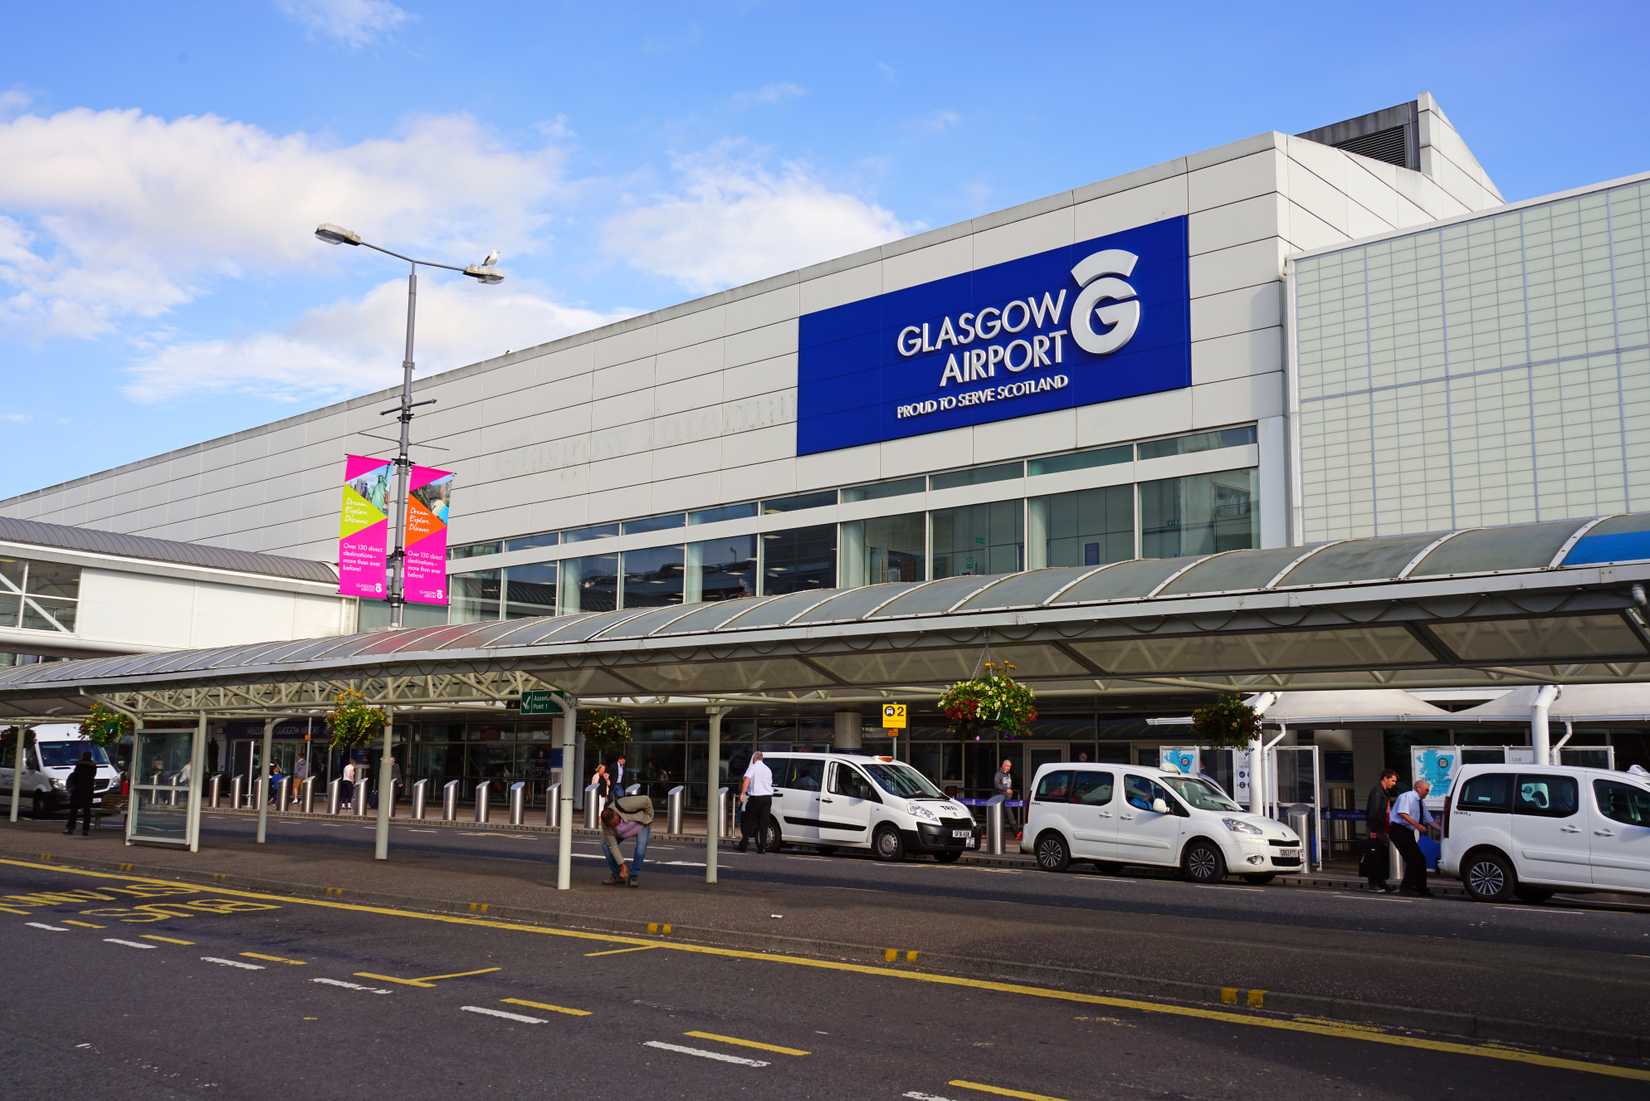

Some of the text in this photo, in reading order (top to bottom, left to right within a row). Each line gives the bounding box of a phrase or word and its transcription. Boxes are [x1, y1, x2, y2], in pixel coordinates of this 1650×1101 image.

[896, 289, 1067, 357] GLASGOW
[939, 330, 1068, 387] AIRPORT
[896, 374, 1068, 419] PROUD TO SERVE SCOTLAND
[897, 706, 905, 717] 2
